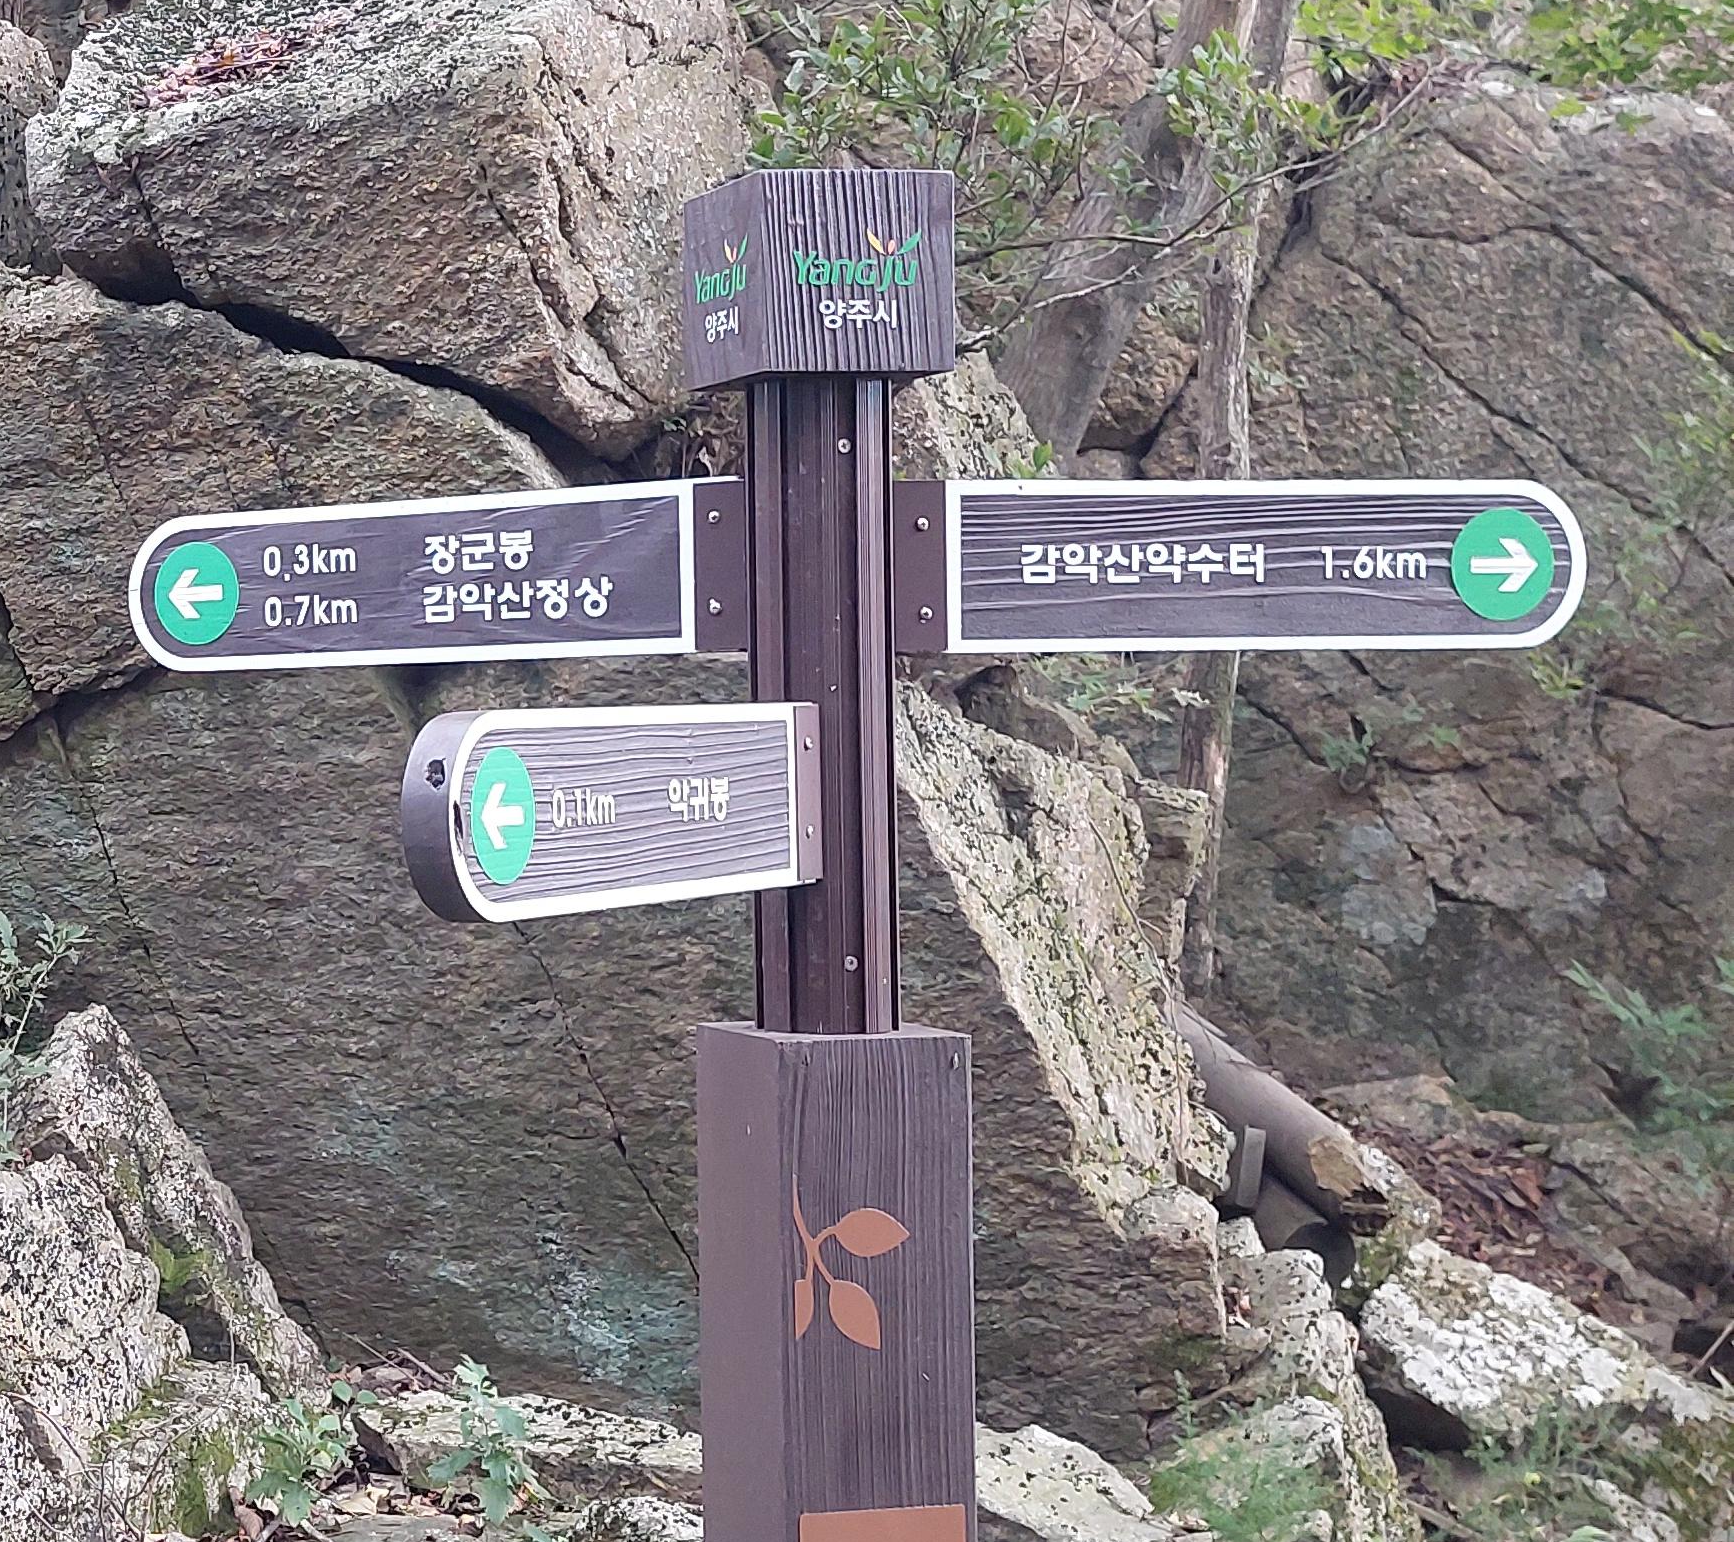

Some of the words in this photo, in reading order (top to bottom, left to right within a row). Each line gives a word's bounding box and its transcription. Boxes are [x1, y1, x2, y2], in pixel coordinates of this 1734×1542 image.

[704, 305, 740, 343] 양주시
[818, 298, 898, 329] 양주시
[263, 544, 357, 582] 0.3km
[423, 529, 534, 574] 장군봉
[1019, 542, 1266, 584] 감악산약수터
[1319, 545, 1428, 581] 1.6km
[264, 595, 359, 627] 0.7km
[422, 576, 614, 625] 감악산정상
[552, 788, 616, 828] 0.1km
[668, 776, 730, 822] 악귀봉
